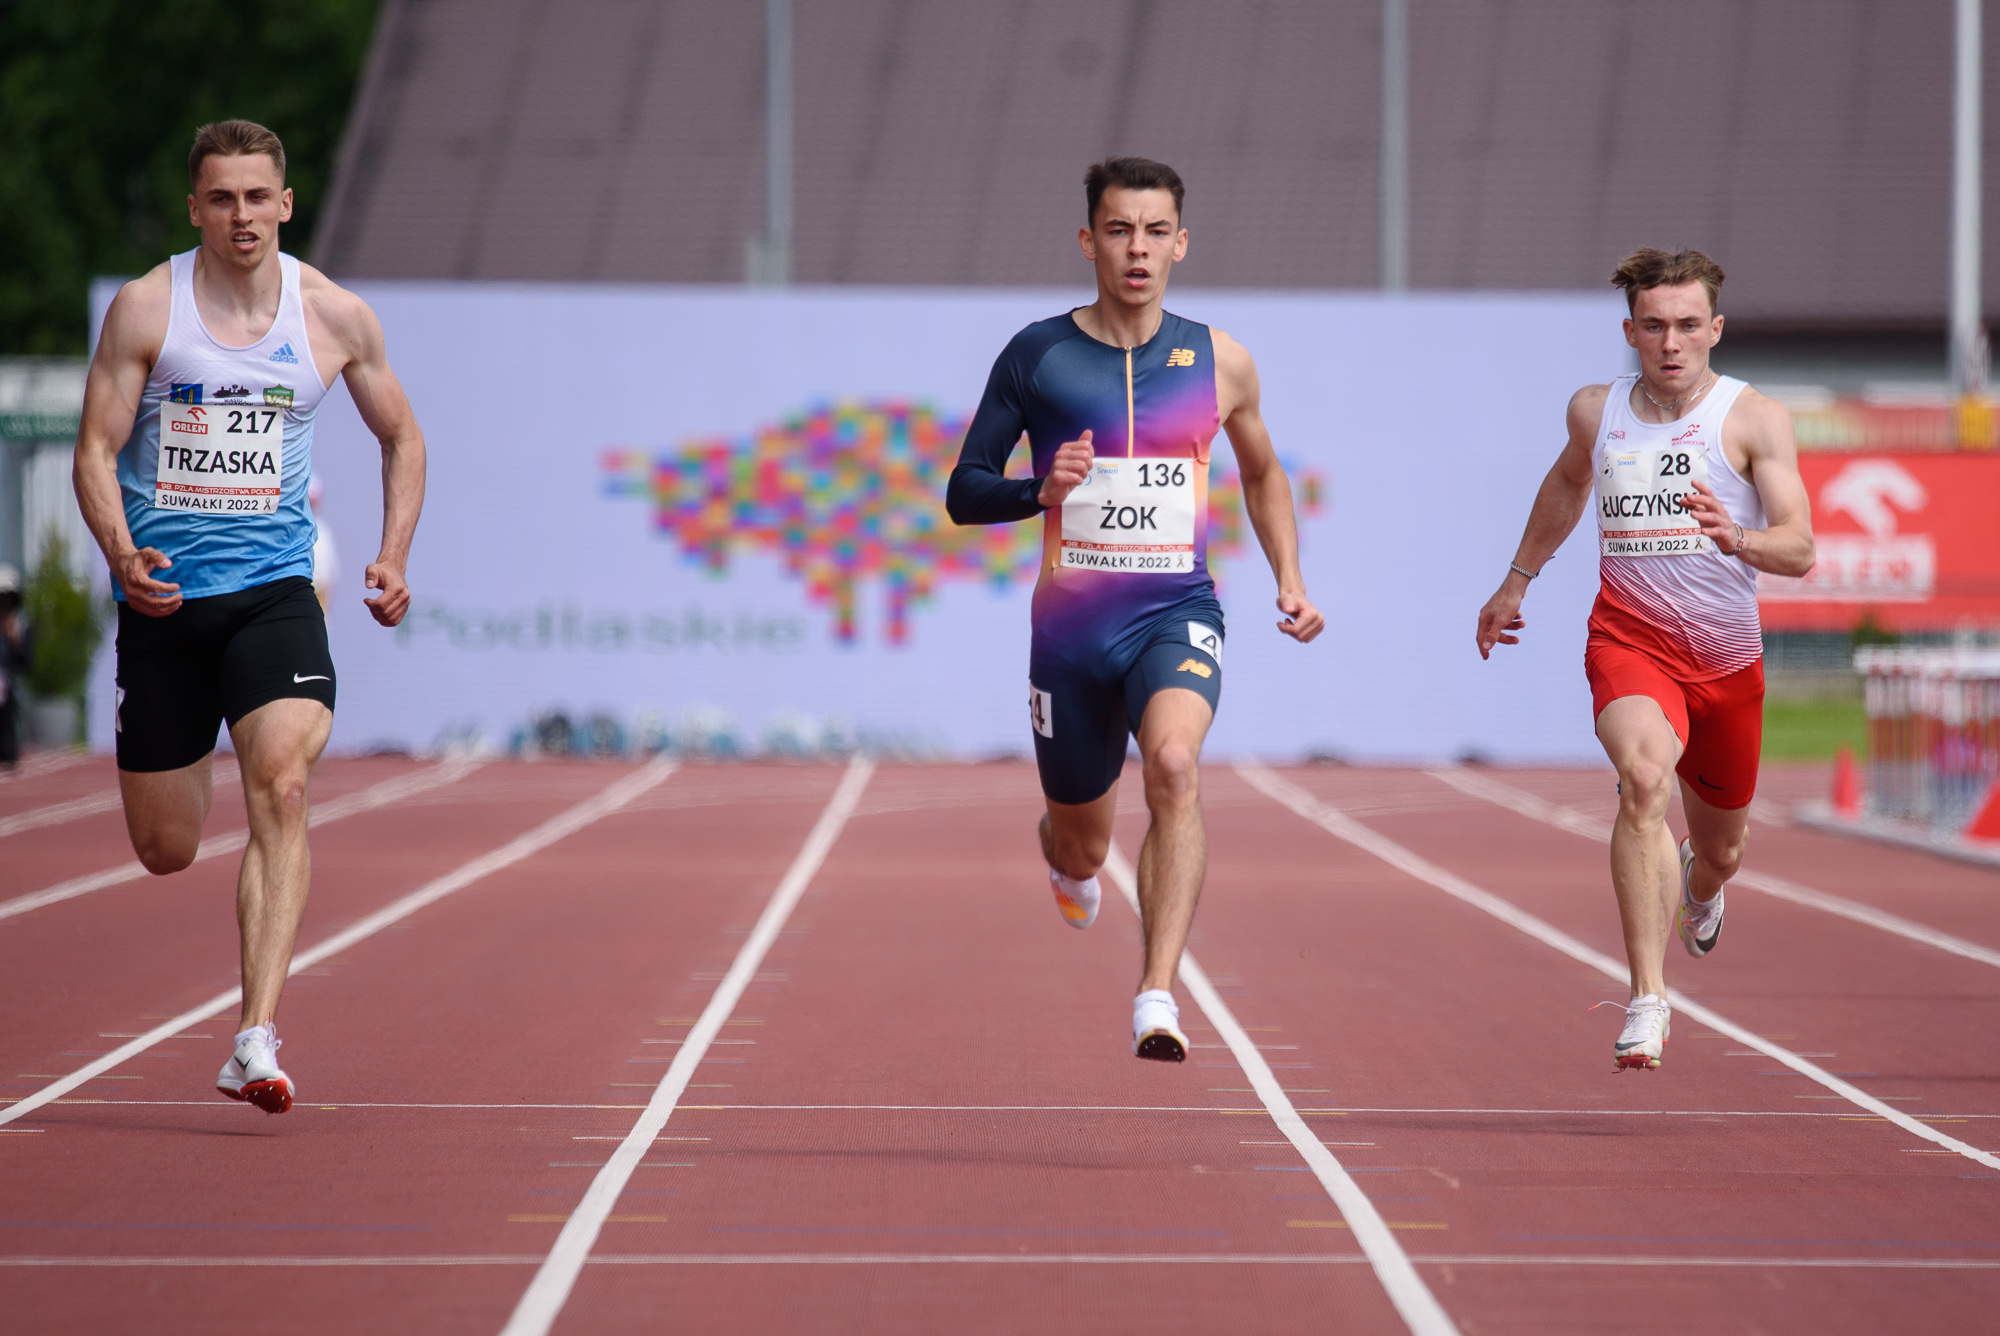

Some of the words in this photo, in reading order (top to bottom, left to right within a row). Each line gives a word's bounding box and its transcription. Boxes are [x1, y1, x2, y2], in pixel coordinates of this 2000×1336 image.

[269, 355, 299, 364] adidas
[172, 421, 207, 434] ORLEN
[226, 410, 277, 434] 217
[164, 445, 276, 475] TRZASKA
[1659, 453, 1691, 477] 28
[1137, 463, 1186, 488] 136
[174, 483, 194, 493] PZLA
[194, 485, 250, 495] MISTRZOSTWA
[161, 494, 222, 510] SUWAŁKI
[226, 499, 259, 511] 2022
[1602, 488, 1698, 518] ŁUCZYŃS
[1099, 499, 1158, 530] ŻOK
[1626, 529, 1679, 538] MISTRZOSTWA
[1081, 543, 1101, 551] PZLA
[1102, 544, 1161, 552] MISTRZOSTWA
[1607, 541, 1653, 553] SUWAŁKI
[1656, 539, 1689, 552] 2022
[1067, 552, 1132, 568] SUWAŁKI
[1137, 557, 1172, 569] 2022
[1201, 634, 1218, 659] 4
[1033, 693, 1046, 732] 4
